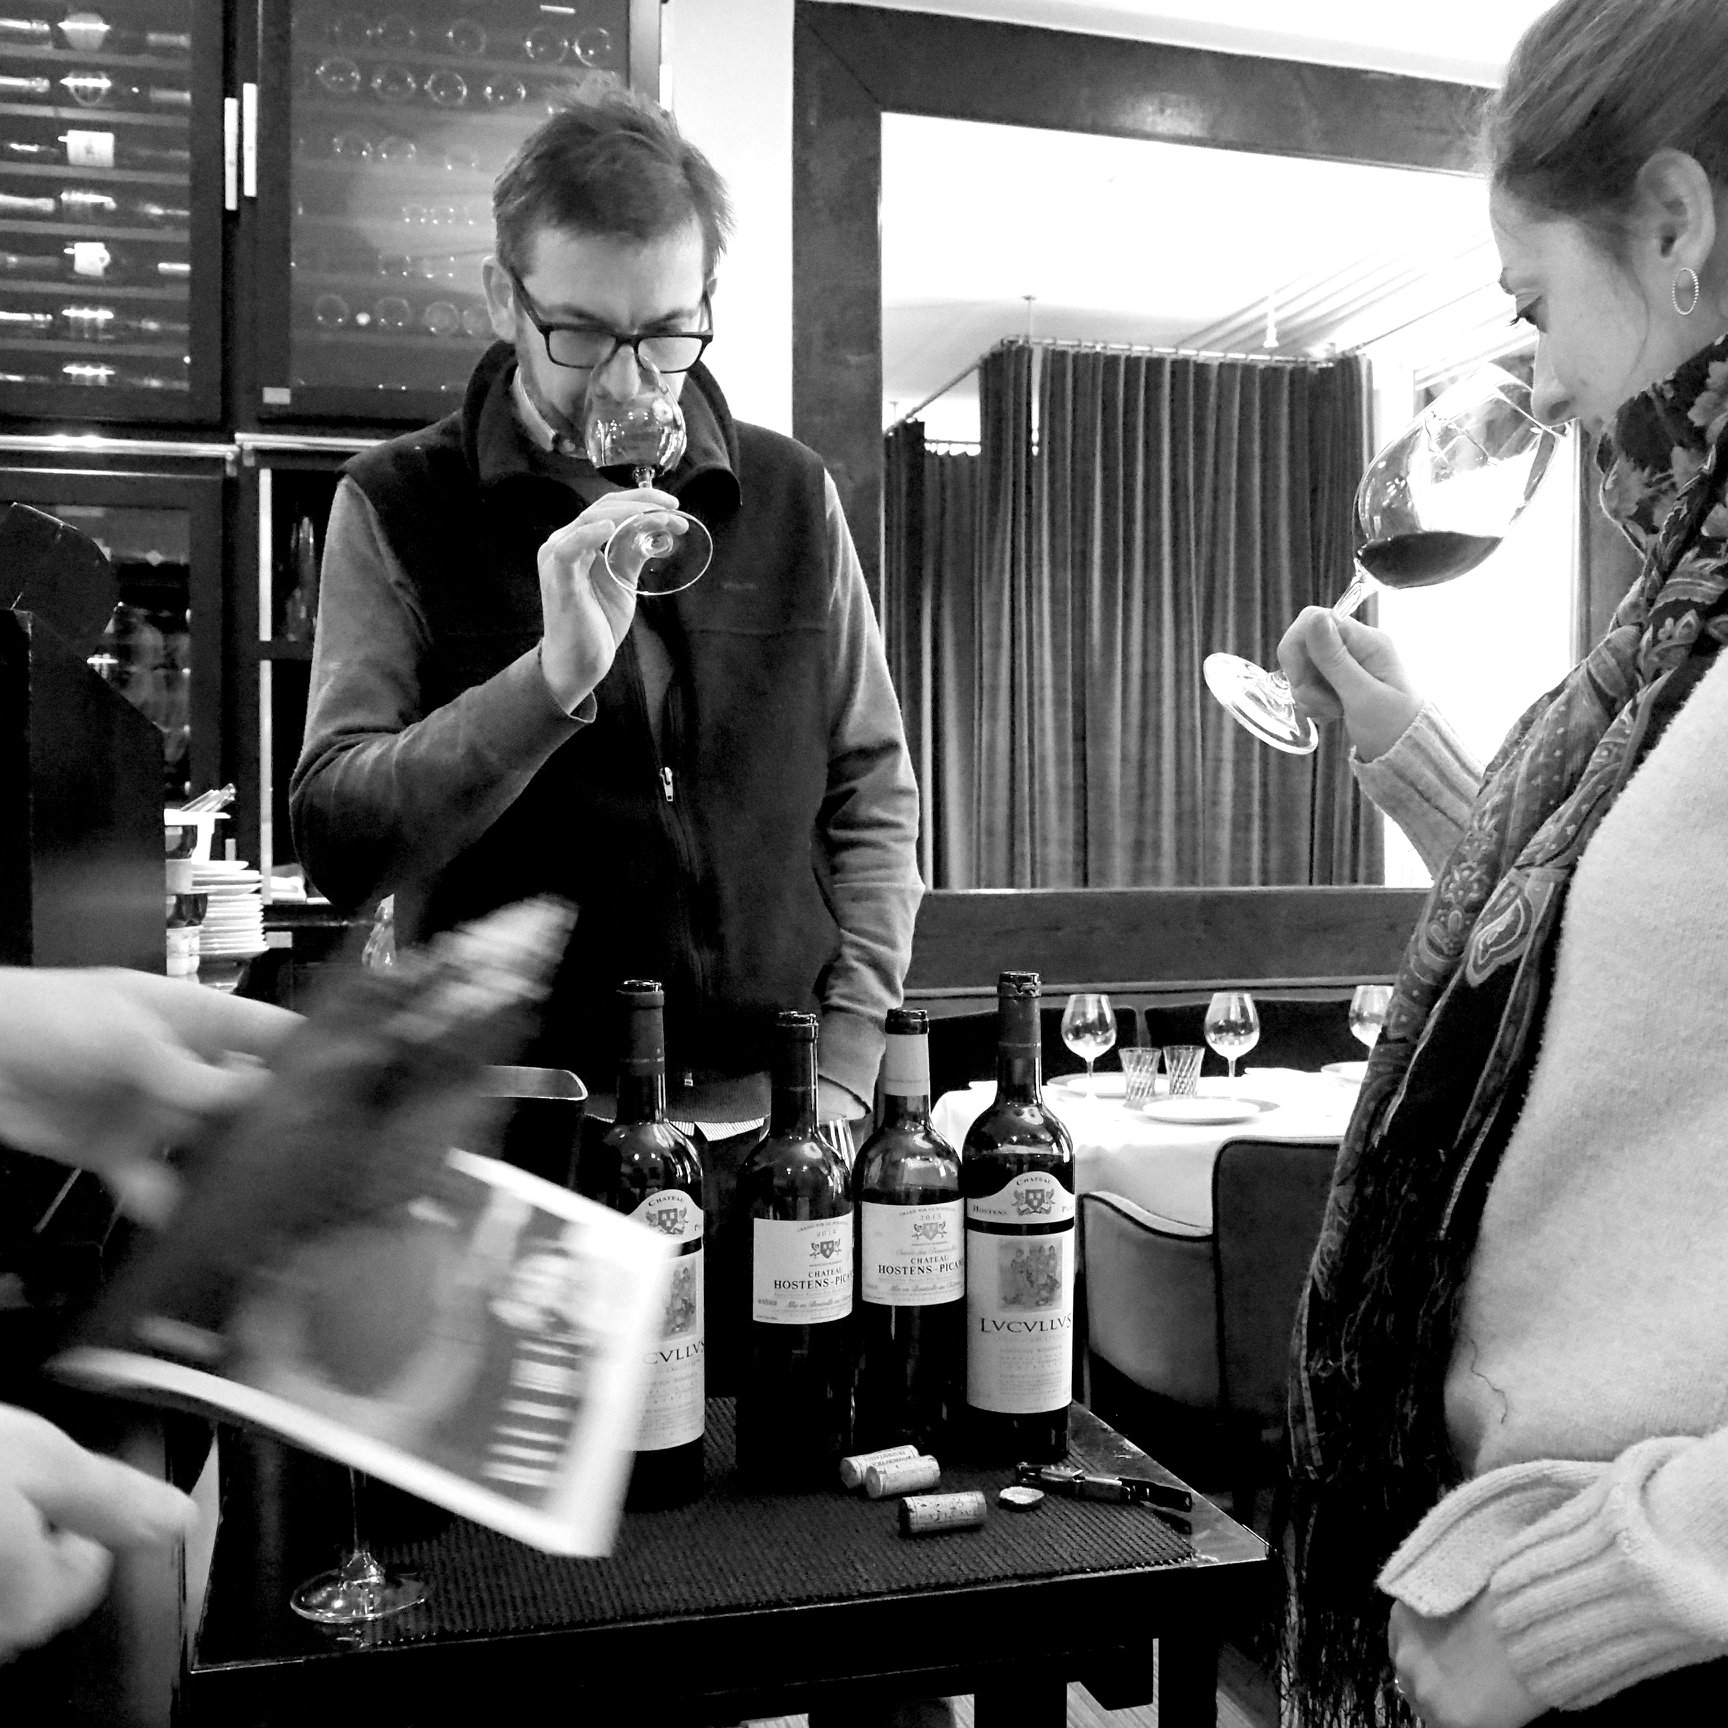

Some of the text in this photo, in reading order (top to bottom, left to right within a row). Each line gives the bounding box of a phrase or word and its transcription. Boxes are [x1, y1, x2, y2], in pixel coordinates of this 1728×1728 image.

[648, 1195, 685, 1207] CHATEAU
[910, 1254, 948, 1265] CHATEAU
[808, 1267, 843, 1279] CHATEAU
[980, 1312, 1073, 1334] LVCVLLVS
[642, 1340, 705, 1364] CVLLVS
